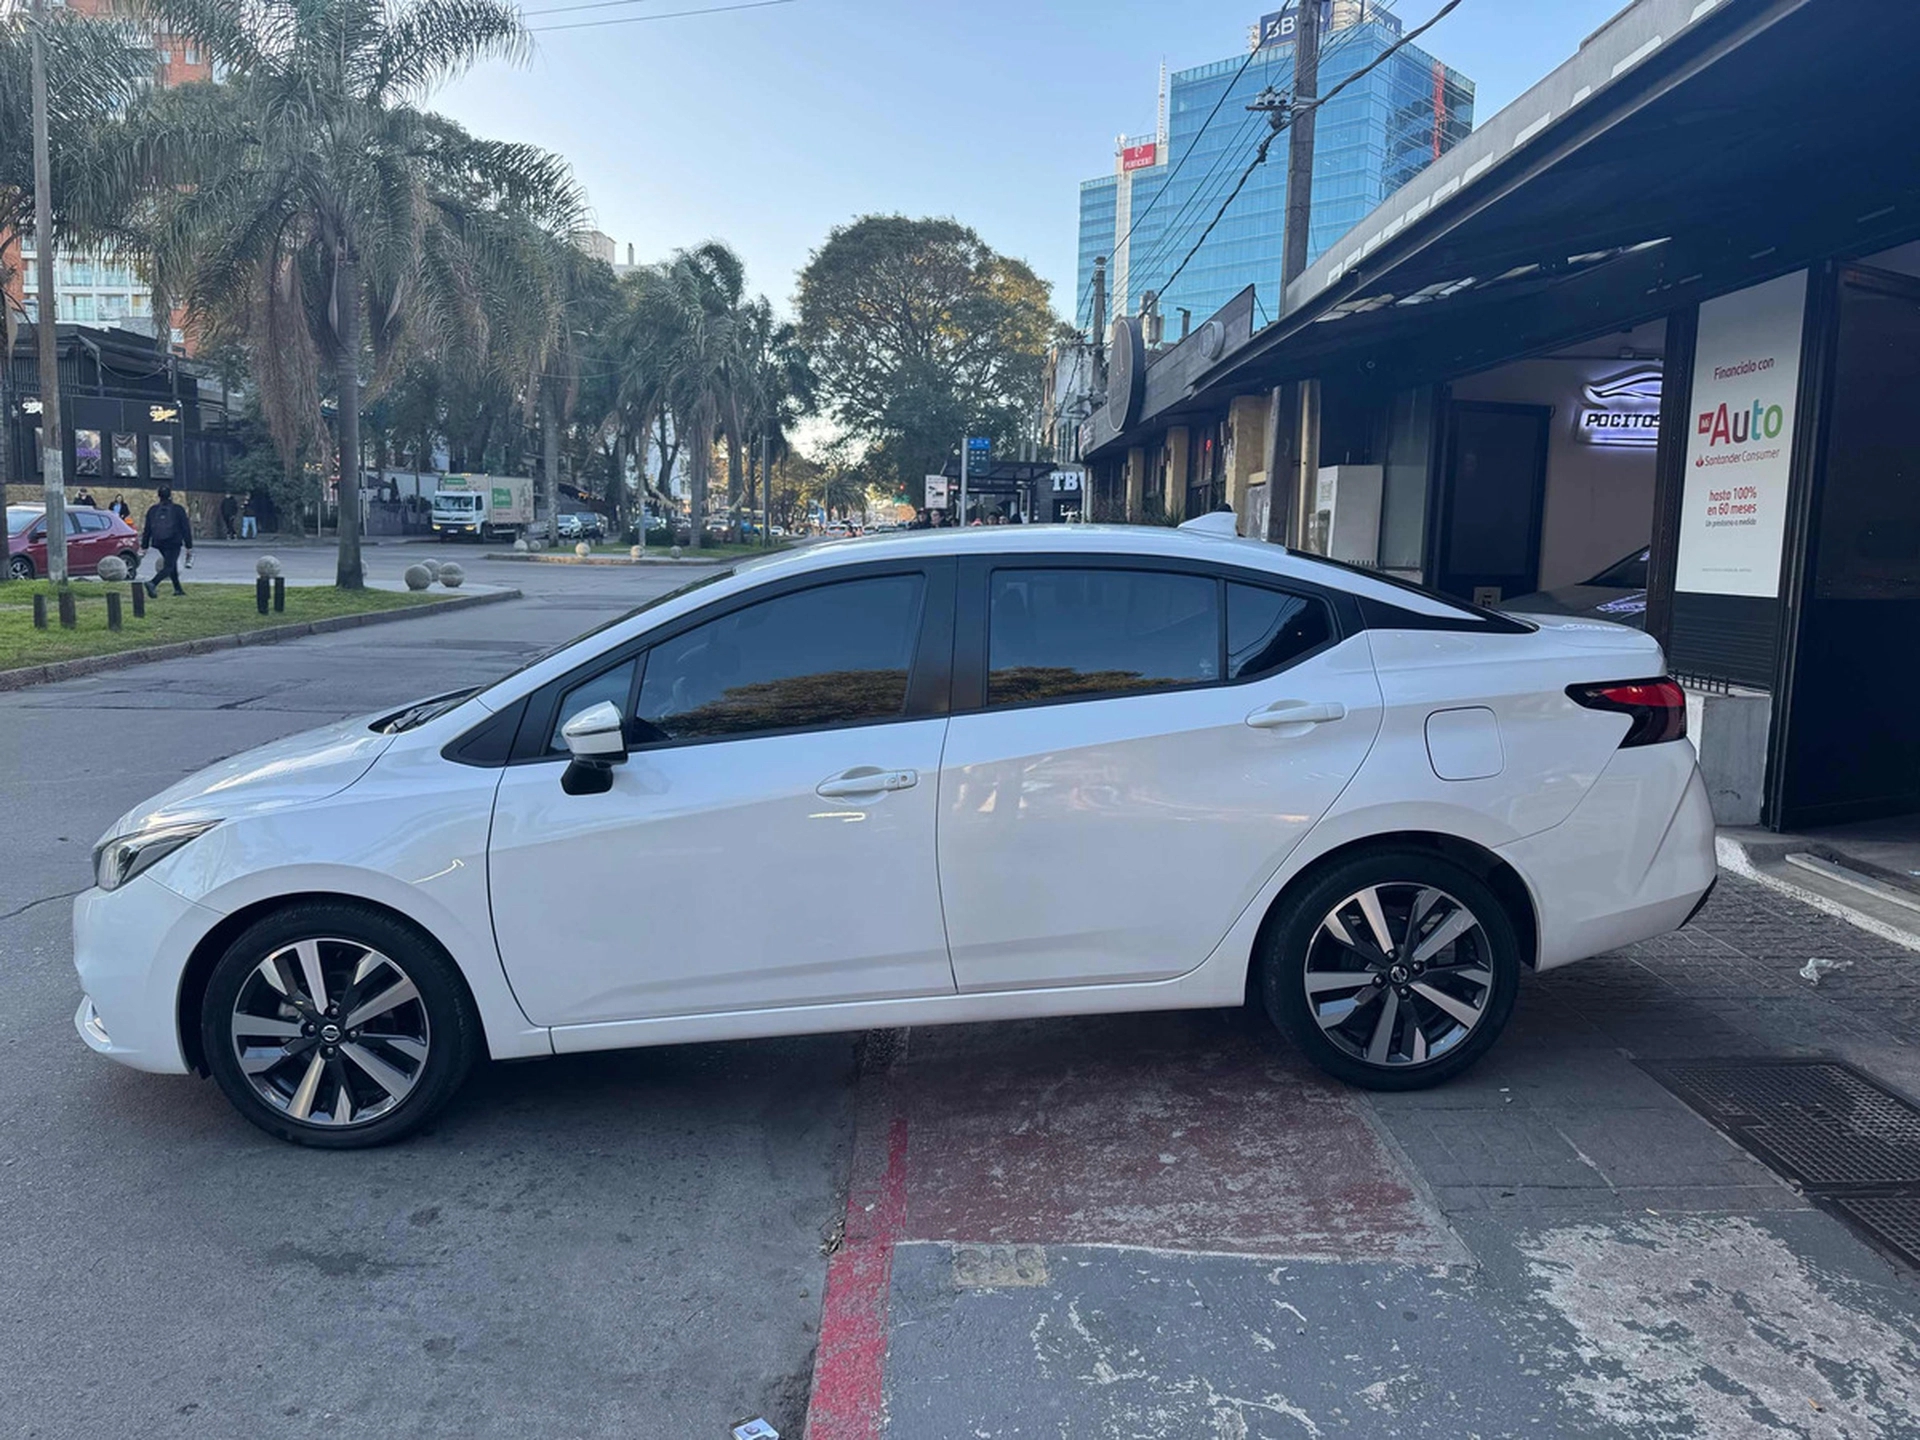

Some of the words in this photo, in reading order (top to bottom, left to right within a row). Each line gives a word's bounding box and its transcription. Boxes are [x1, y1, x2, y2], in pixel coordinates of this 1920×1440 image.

[1758, 358, 1776, 371] con
[1709, 399, 1783, 447] Auto
[1705, 452, 1741, 467] Santander
[1742, 449, 1780, 463] Consumer
[1709, 489, 1731, 501] hasta
[1733, 486, 1757, 500] 100%
[1707, 506, 1717, 516] en
[1718, 502, 1729, 515] 60
[1730, 503, 1757, 515] meses
